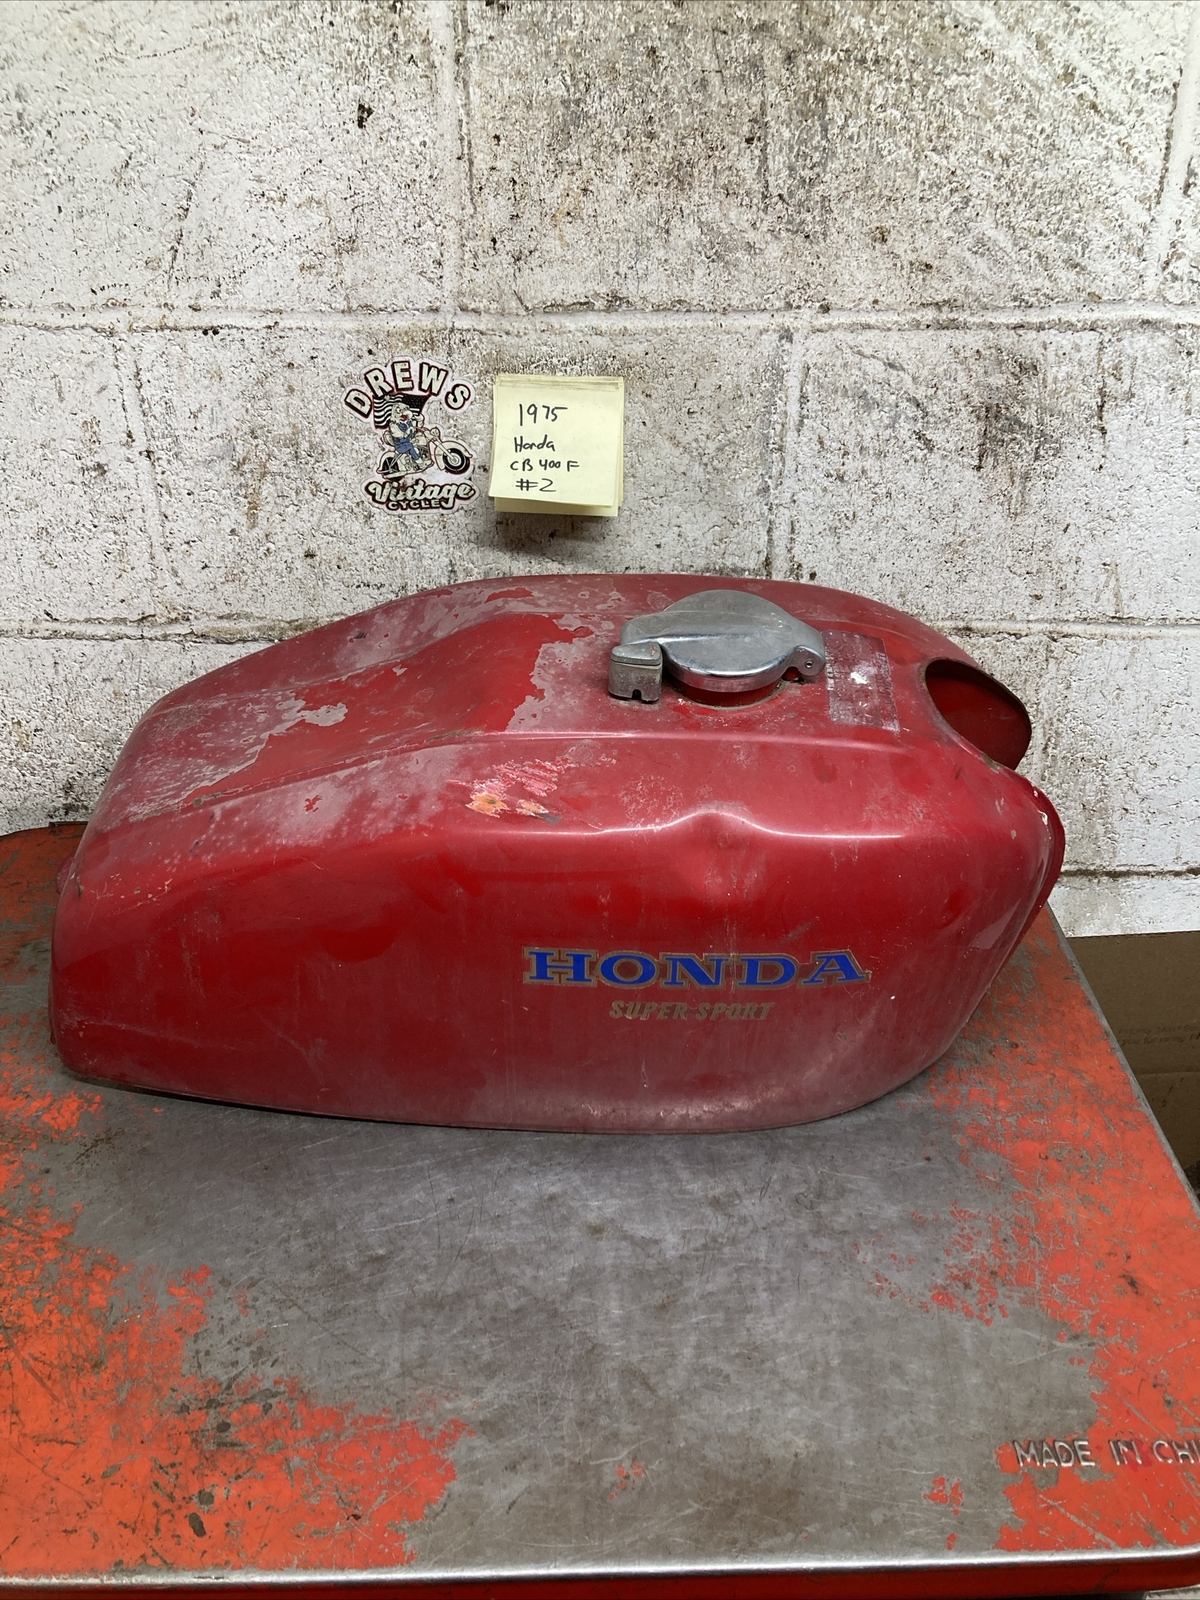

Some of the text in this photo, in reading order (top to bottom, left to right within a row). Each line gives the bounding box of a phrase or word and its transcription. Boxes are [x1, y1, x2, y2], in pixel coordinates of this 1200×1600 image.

[518, 403, 568, 427] 1975
[513, 434, 556, 452] Honda
[510, 457, 580, 472] CB 400 F
[364, 479, 476, 510] Vintage
[515, 478, 557, 493] #2
[523, 946, 872, 989] HONDA
[609, 1000, 775, 1021] SUPER SPORT
[1012, 1440, 1096, 1467] MADE
[1108, 1439, 1143, 1466] IN
